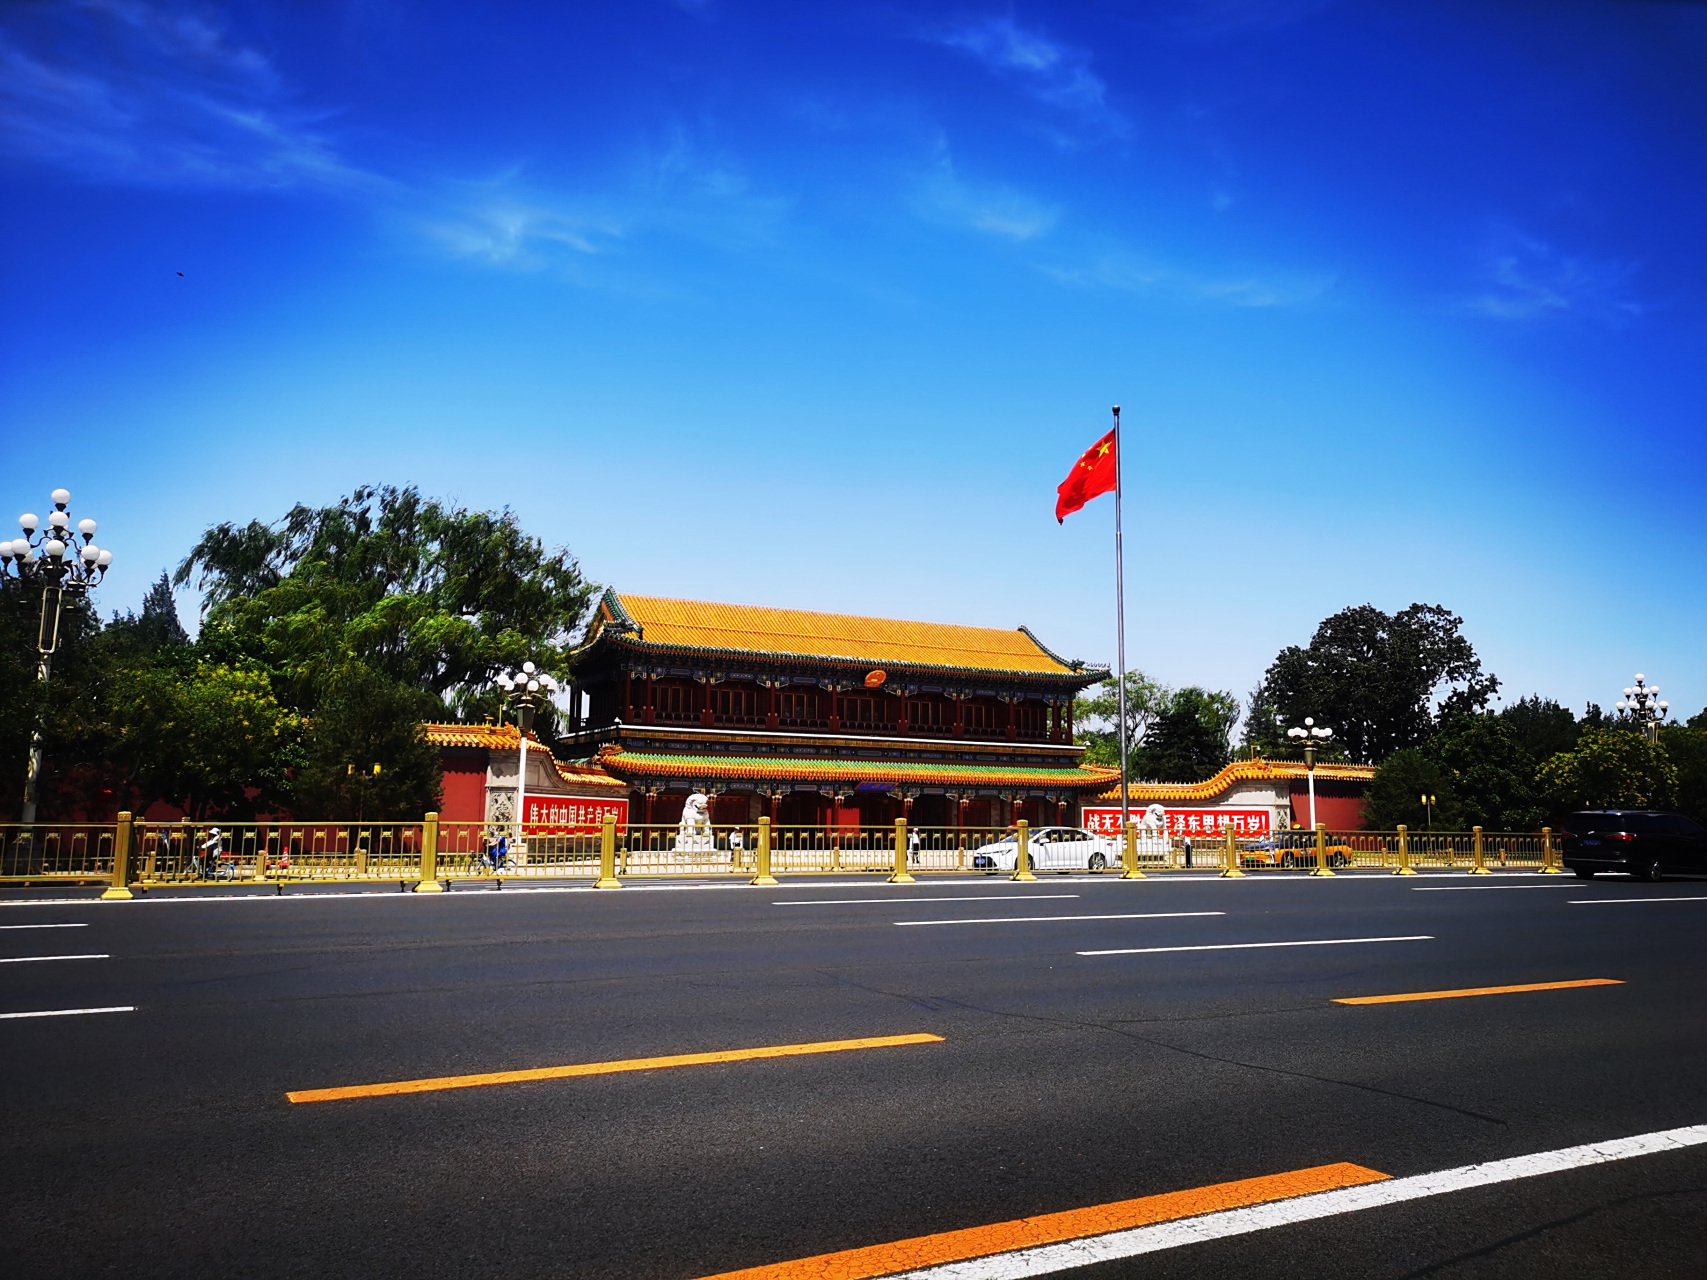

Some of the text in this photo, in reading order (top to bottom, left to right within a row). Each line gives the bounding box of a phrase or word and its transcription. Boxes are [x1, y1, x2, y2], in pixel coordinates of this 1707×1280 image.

[1088, 813, 1267, 834] 战无不胜毛泽东思想万岁!
